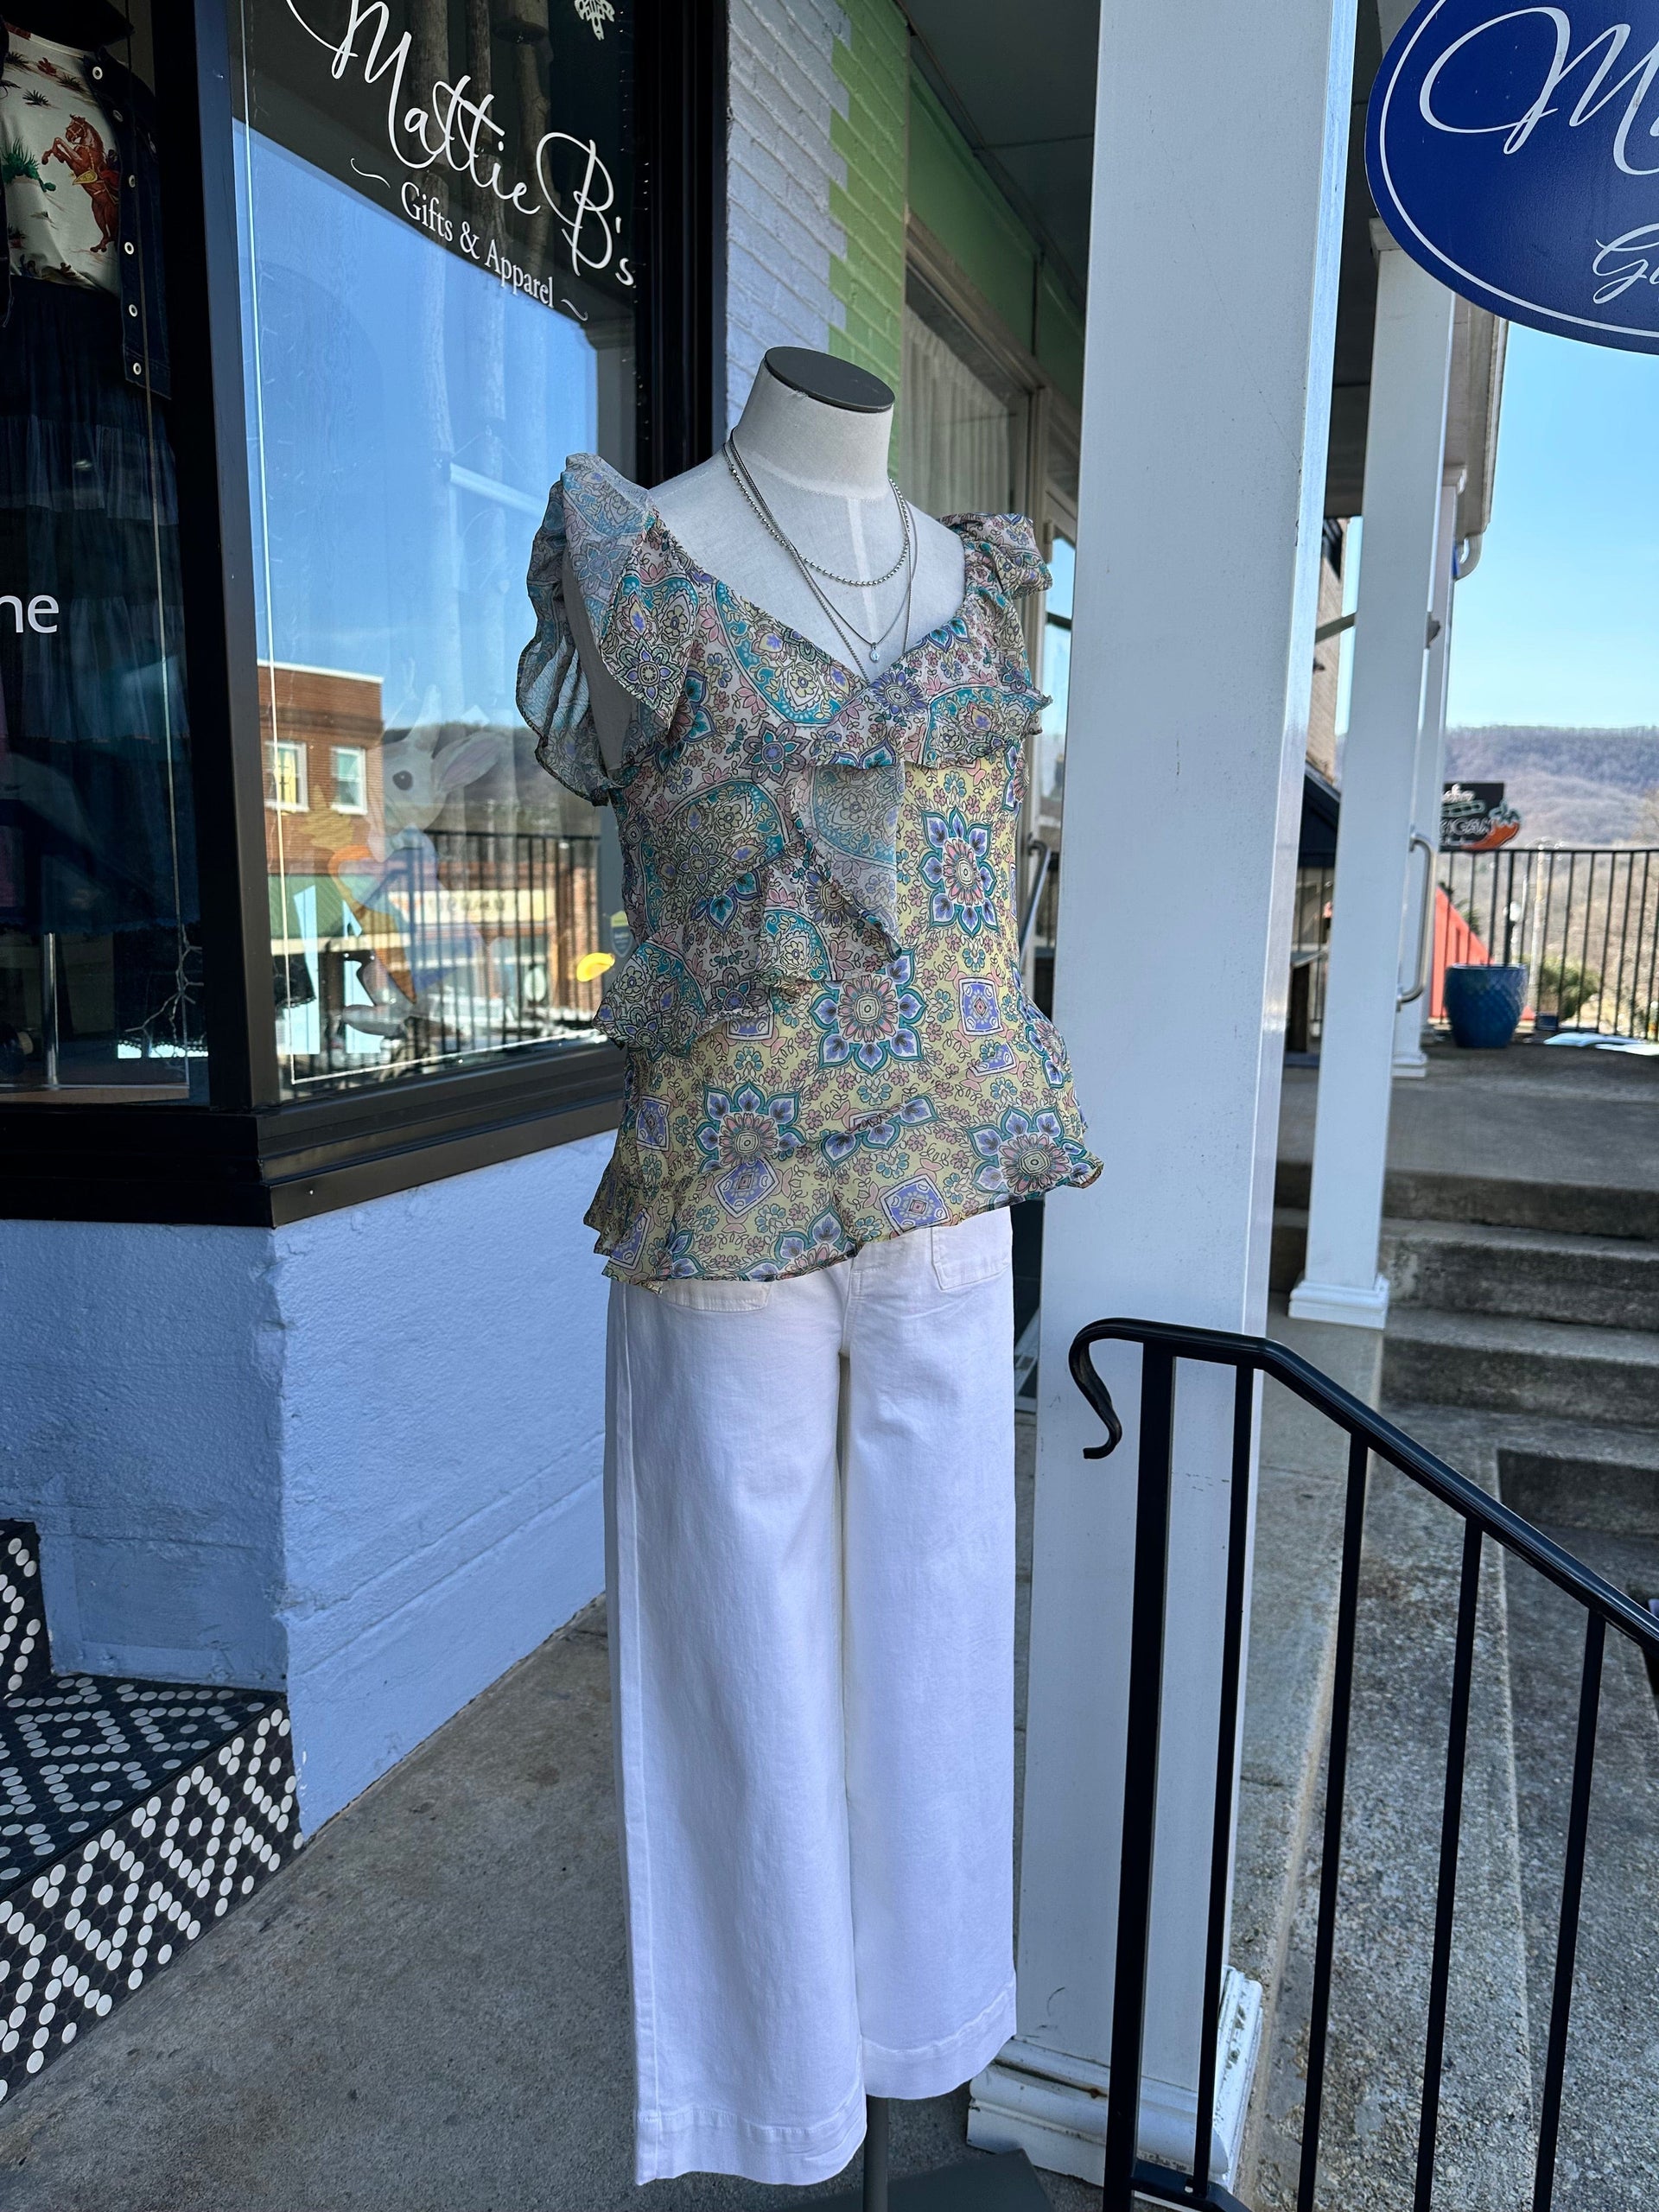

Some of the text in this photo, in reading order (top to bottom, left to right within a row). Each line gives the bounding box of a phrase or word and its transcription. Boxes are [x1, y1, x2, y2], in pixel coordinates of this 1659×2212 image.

[287, 0, 541, 215] Mattie
[1419, 7, 1659, 175] M
[401, 181, 555, 308] Gifts & Apparel
